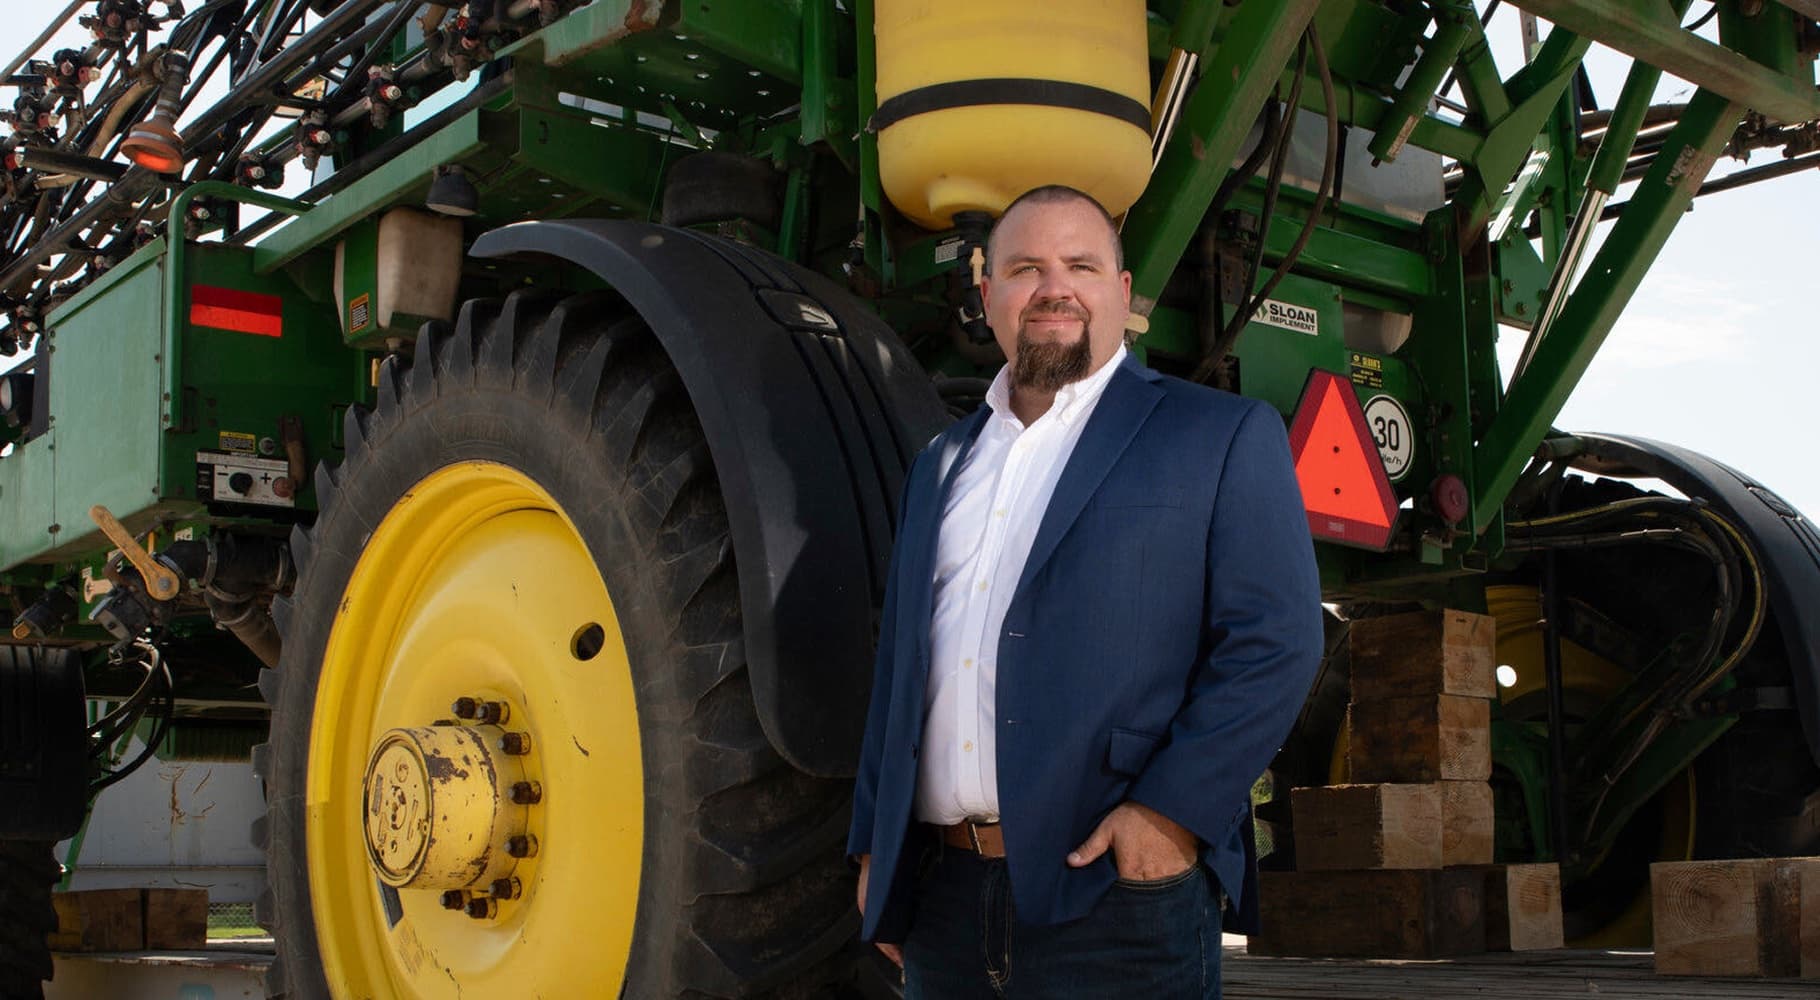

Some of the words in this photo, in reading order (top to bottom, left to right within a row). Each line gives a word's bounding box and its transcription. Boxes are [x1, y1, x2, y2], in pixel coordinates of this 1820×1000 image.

[1269, 303, 1315, 324] SLOAN
[1270, 315, 1315, 331] IMPLEMENT
[1374, 416, 1399, 451] 30
